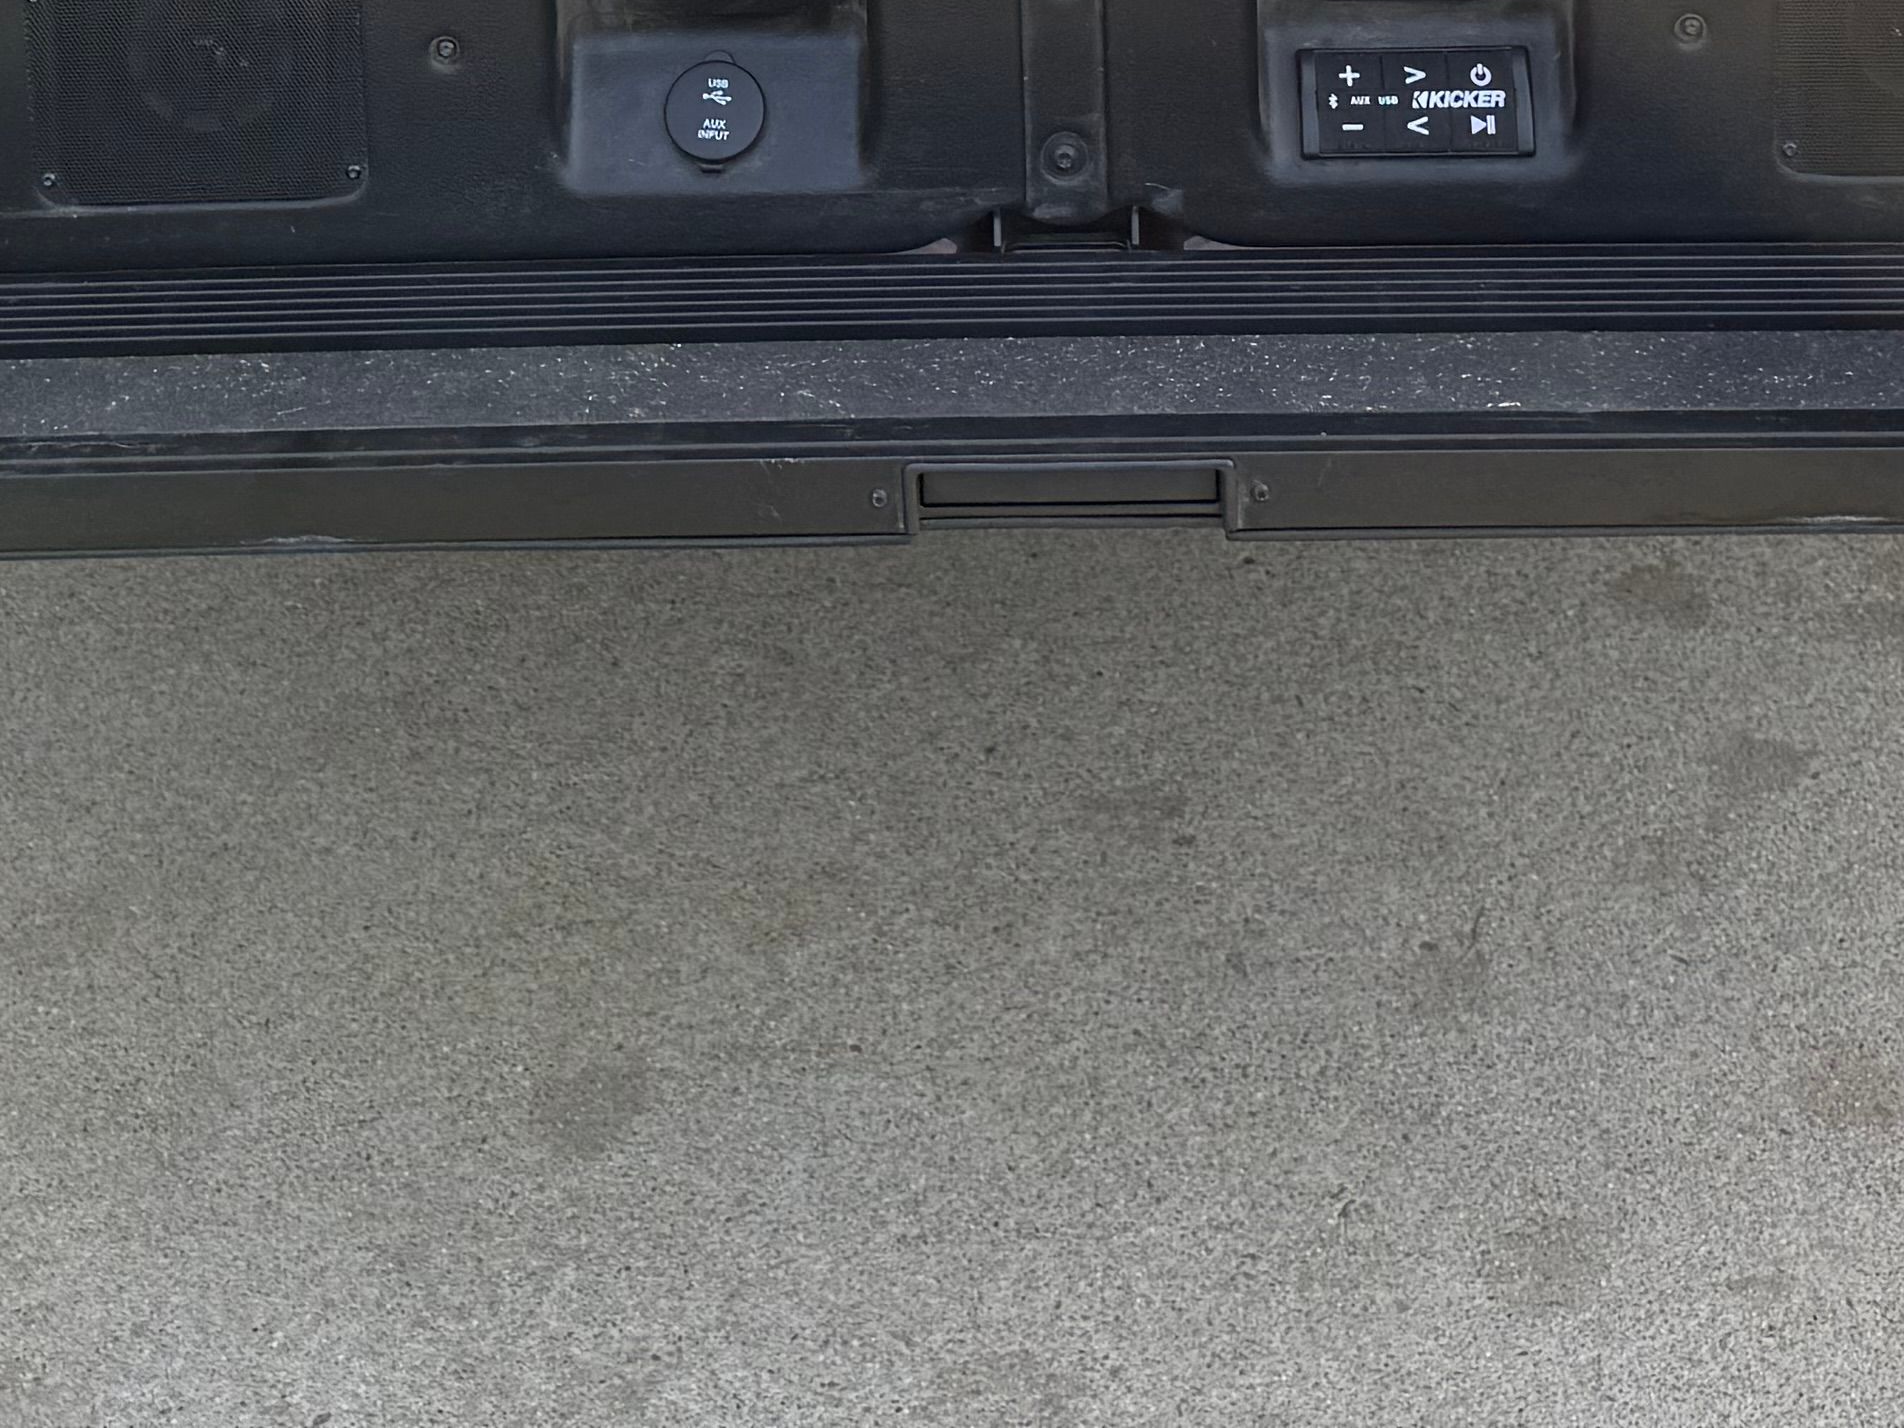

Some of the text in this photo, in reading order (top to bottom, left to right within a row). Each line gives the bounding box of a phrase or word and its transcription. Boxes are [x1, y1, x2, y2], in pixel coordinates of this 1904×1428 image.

[707, 77, 729, 89] USB
[1350, 95, 1371, 105] AUX
[1428, 90, 1506, 108] KICKER
[702, 118, 727, 129] AUX
[697, 129, 730, 141] INPUT
